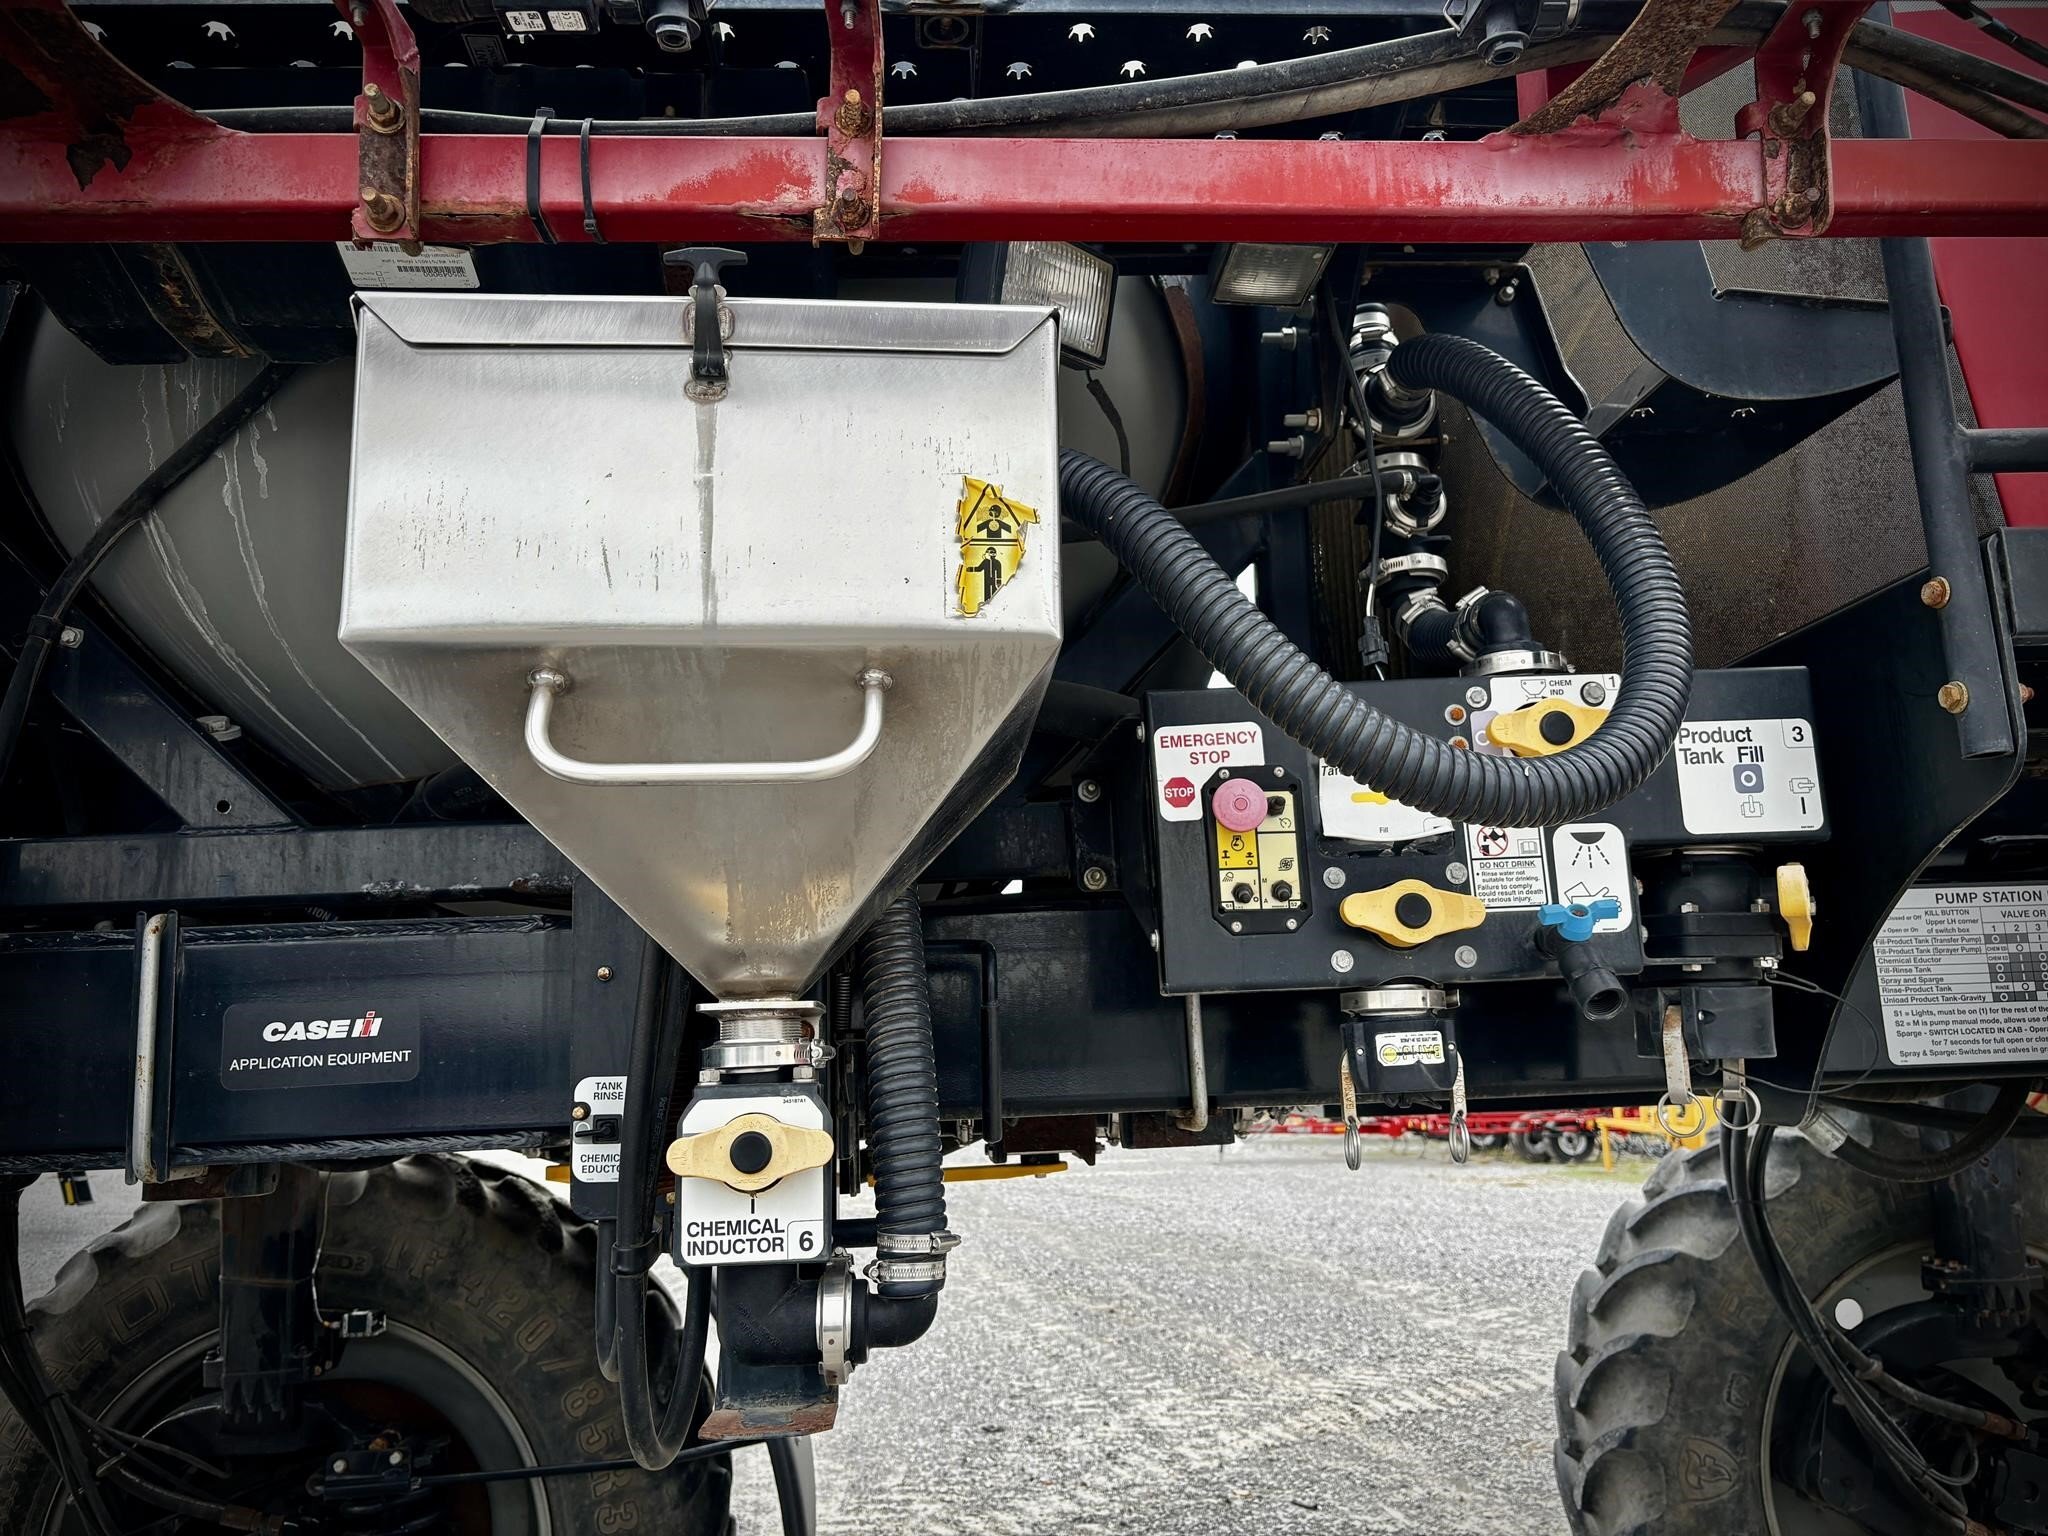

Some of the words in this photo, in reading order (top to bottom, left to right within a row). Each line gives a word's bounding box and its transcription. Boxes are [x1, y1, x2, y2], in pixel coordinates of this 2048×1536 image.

[1608, 676, 1616, 688] 1
[1160, 731, 1256, 748] EMERGENCY
[1679, 726, 1752, 744] Product
[1792, 726, 1804, 742] 3
[1190, 750, 1230, 764] STOP
[1679, 747, 1724, 764] Tank
[1737, 746, 1764, 762] Fill
[1165, 787, 1194, 798] STOP
[1936, 892, 1978, 904] PUMP
[1982, 890, 2042, 902] STATION
[2001, 910, 2030, 918] VALVE
[1926, 919, 1946, 927] Upper
[1931, 937, 1959, 945] (Transfer
[1932, 946, 1959, 956] (Sprayer
[1881, 977, 1902, 986] Spray
[1918, 976, 1944, 984] Sparge
[1941, 994, 1986, 1003] Tank-Gravity
[262, 1019, 350, 1042] CASE
[229, 1054, 323, 1072] APPLICATION
[327, 1050, 412, 1066] EQUIPMENT
[595, 1082, 622, 1090] TANK
[593, 1092, 624, 1100] RINSE
[687, 1218, 785, 1238] CHEMICAL
[800, 1230, 814, 1252] 6
[687, 1237, 784, 1256] INDUCTOR
